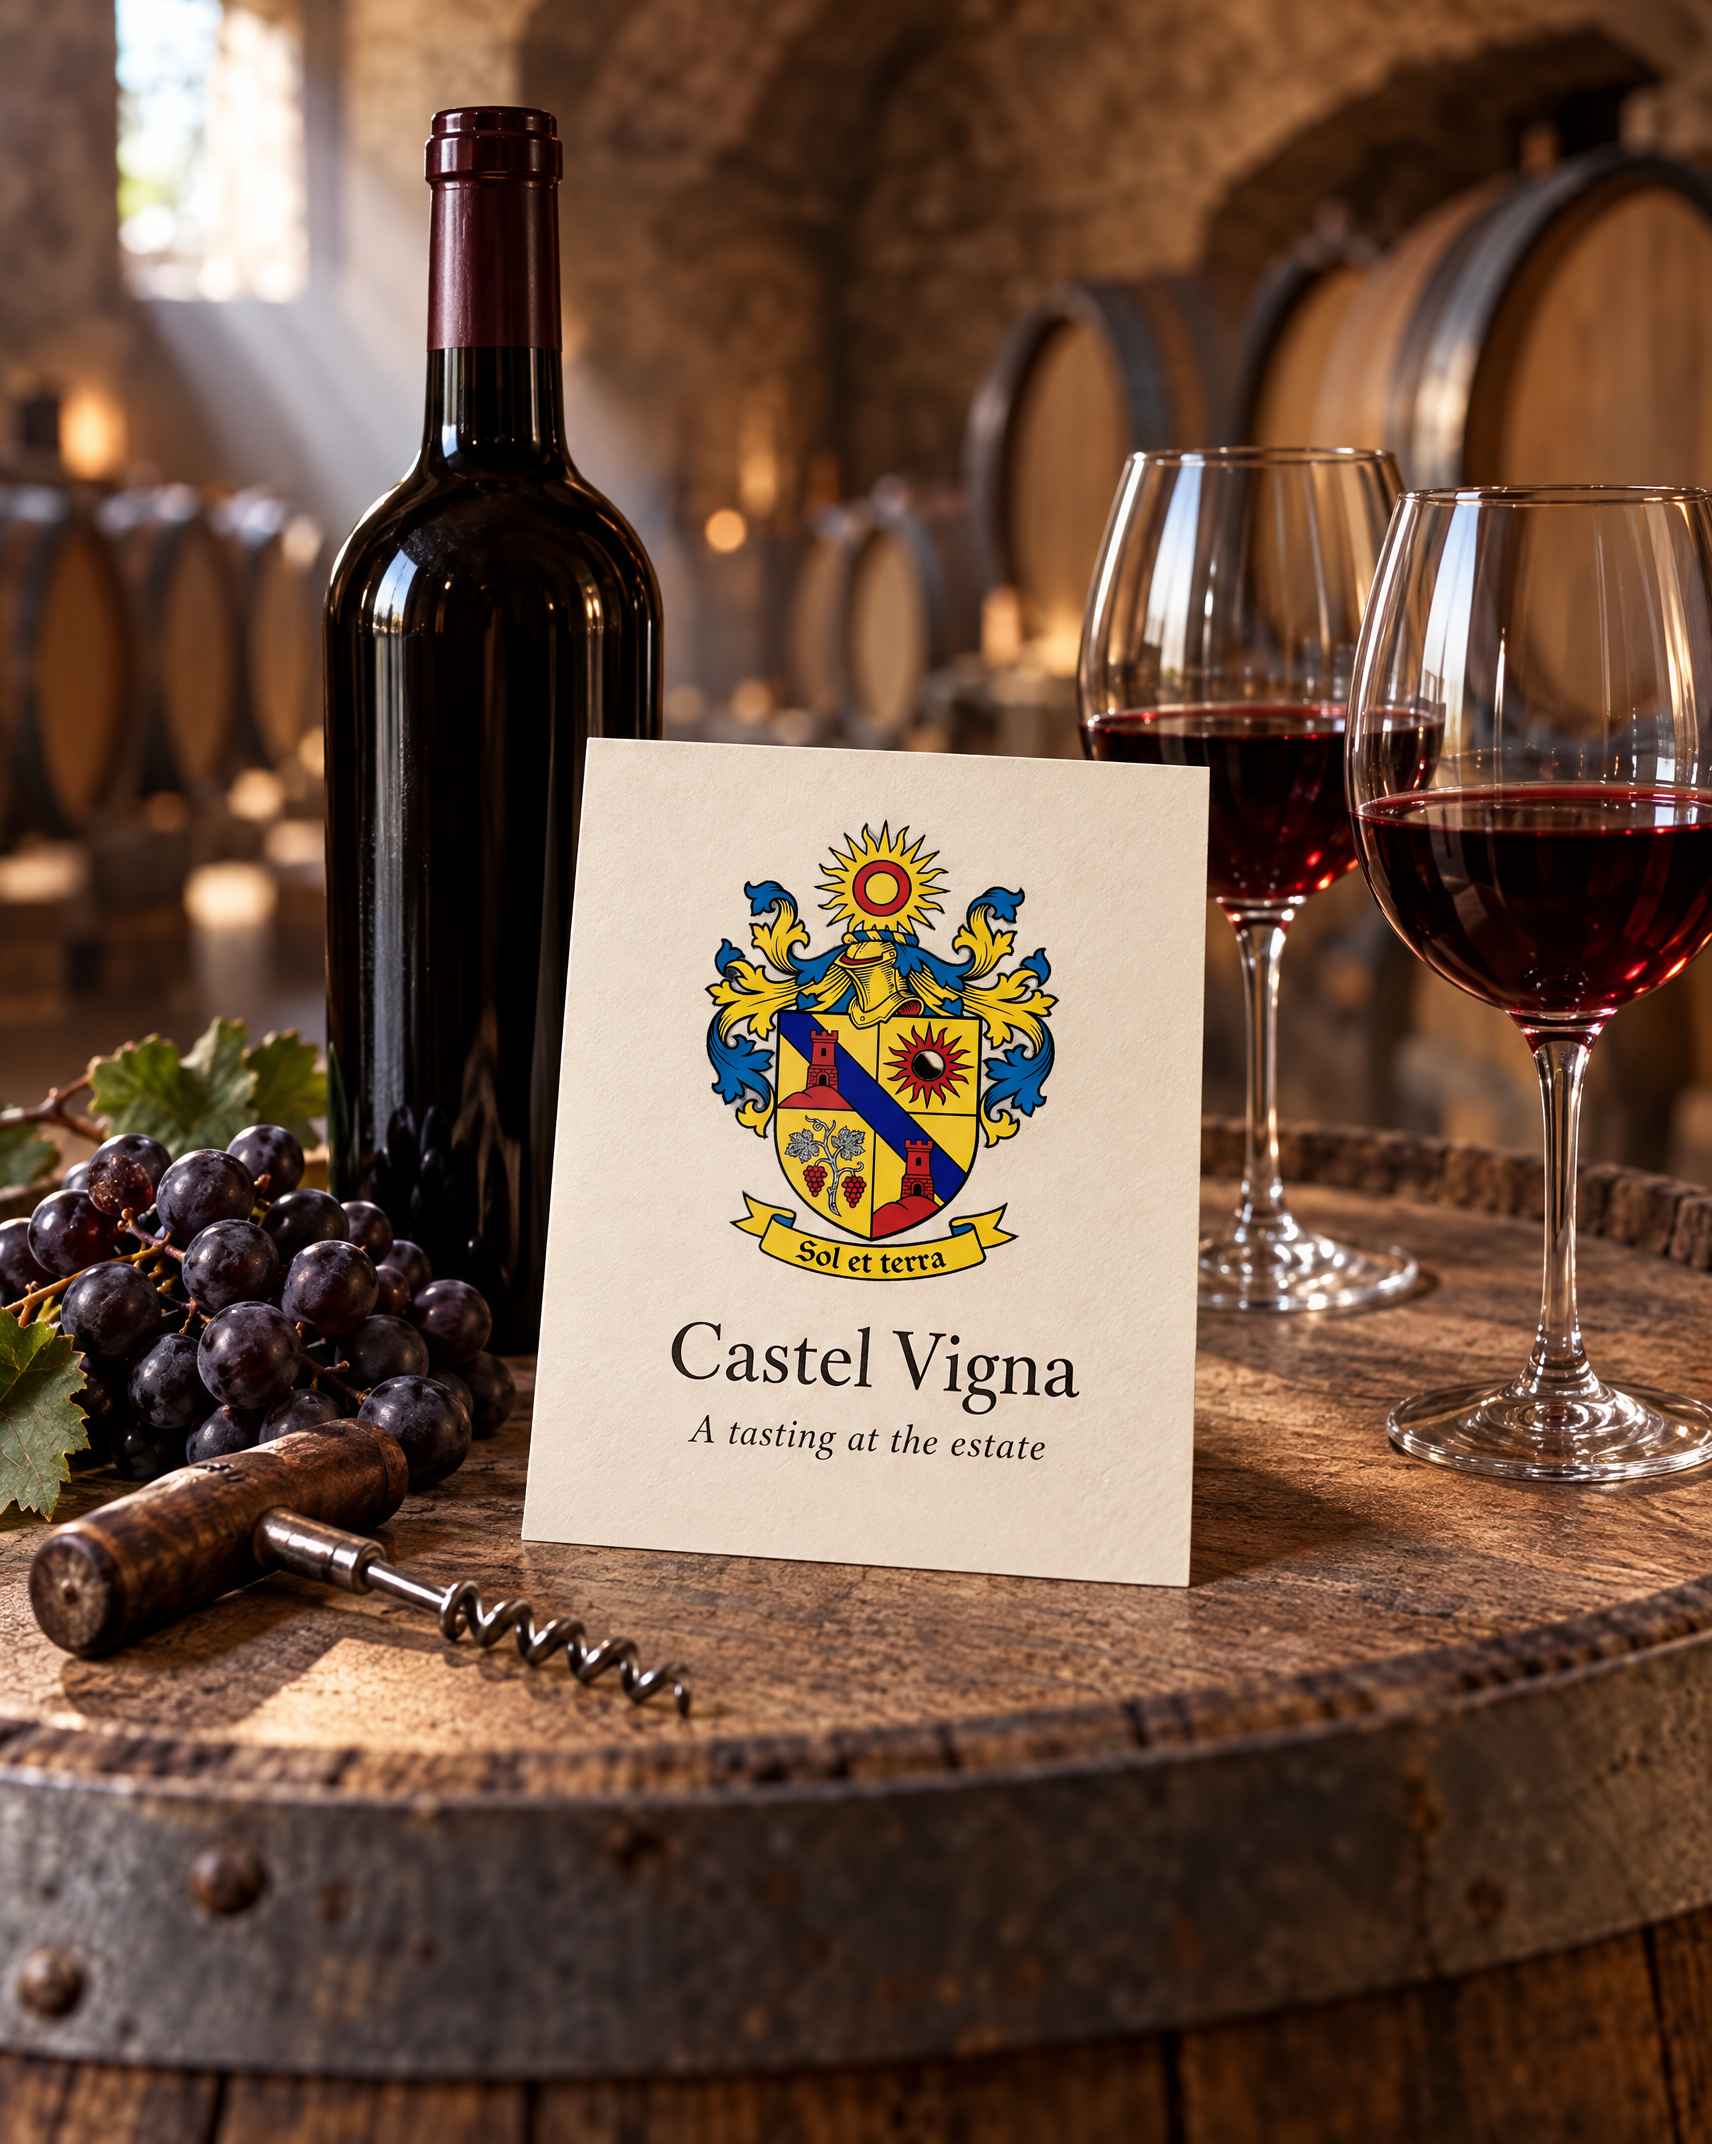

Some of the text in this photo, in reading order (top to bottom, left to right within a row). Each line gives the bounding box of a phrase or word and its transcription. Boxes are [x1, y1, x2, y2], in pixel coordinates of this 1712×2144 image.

[795, 1240, 947, 1274] Sol et terra
[671, 1321, 1080, 1416] Castel Vigna
[687, 1414, 1046, 1461] A tasting at the estate
